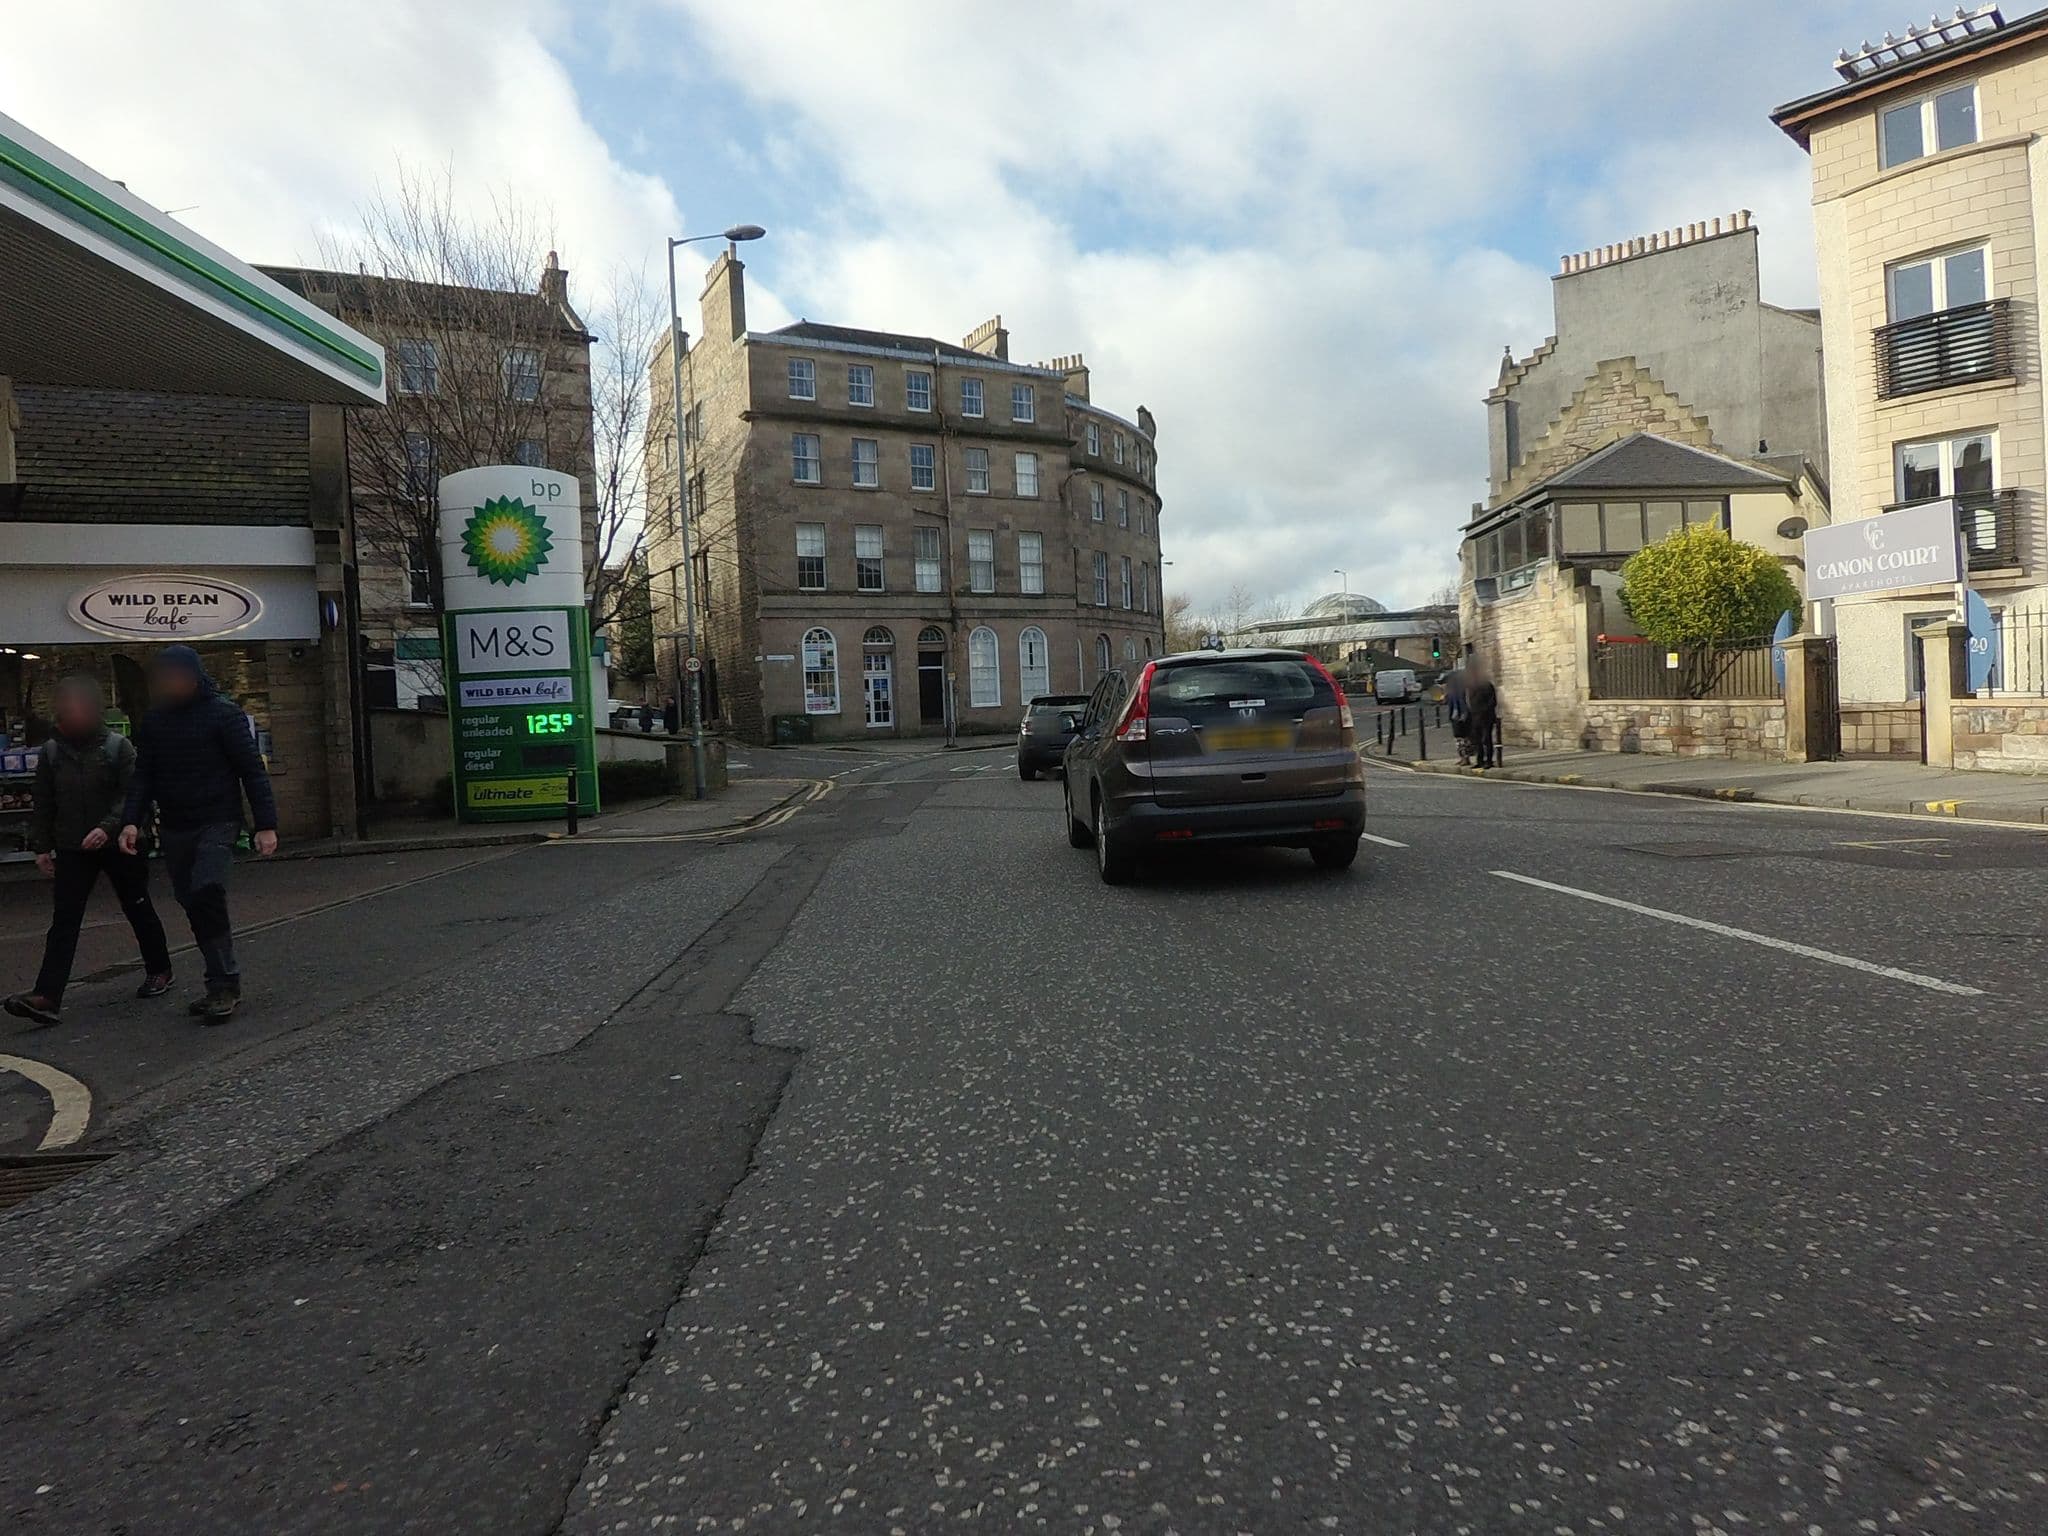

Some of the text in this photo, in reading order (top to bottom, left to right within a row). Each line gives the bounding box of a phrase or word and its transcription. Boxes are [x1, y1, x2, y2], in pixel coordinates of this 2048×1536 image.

[532, 479, 561, 501] bp
[1816, 545, 1940, 580] CANON COURT
[108, 594, 219, 606] WILD BEAN
[470, 625, 554, 659] M&S
[465, 688, 494, 698] WILD
[496, 687, 531, 697] BEAN
[461, 715, 500, 727] regular
[462, 726, 513, 738] unleaded
[463, 748, 502, 760] regular
[464, 761, 494, 771] diesel
